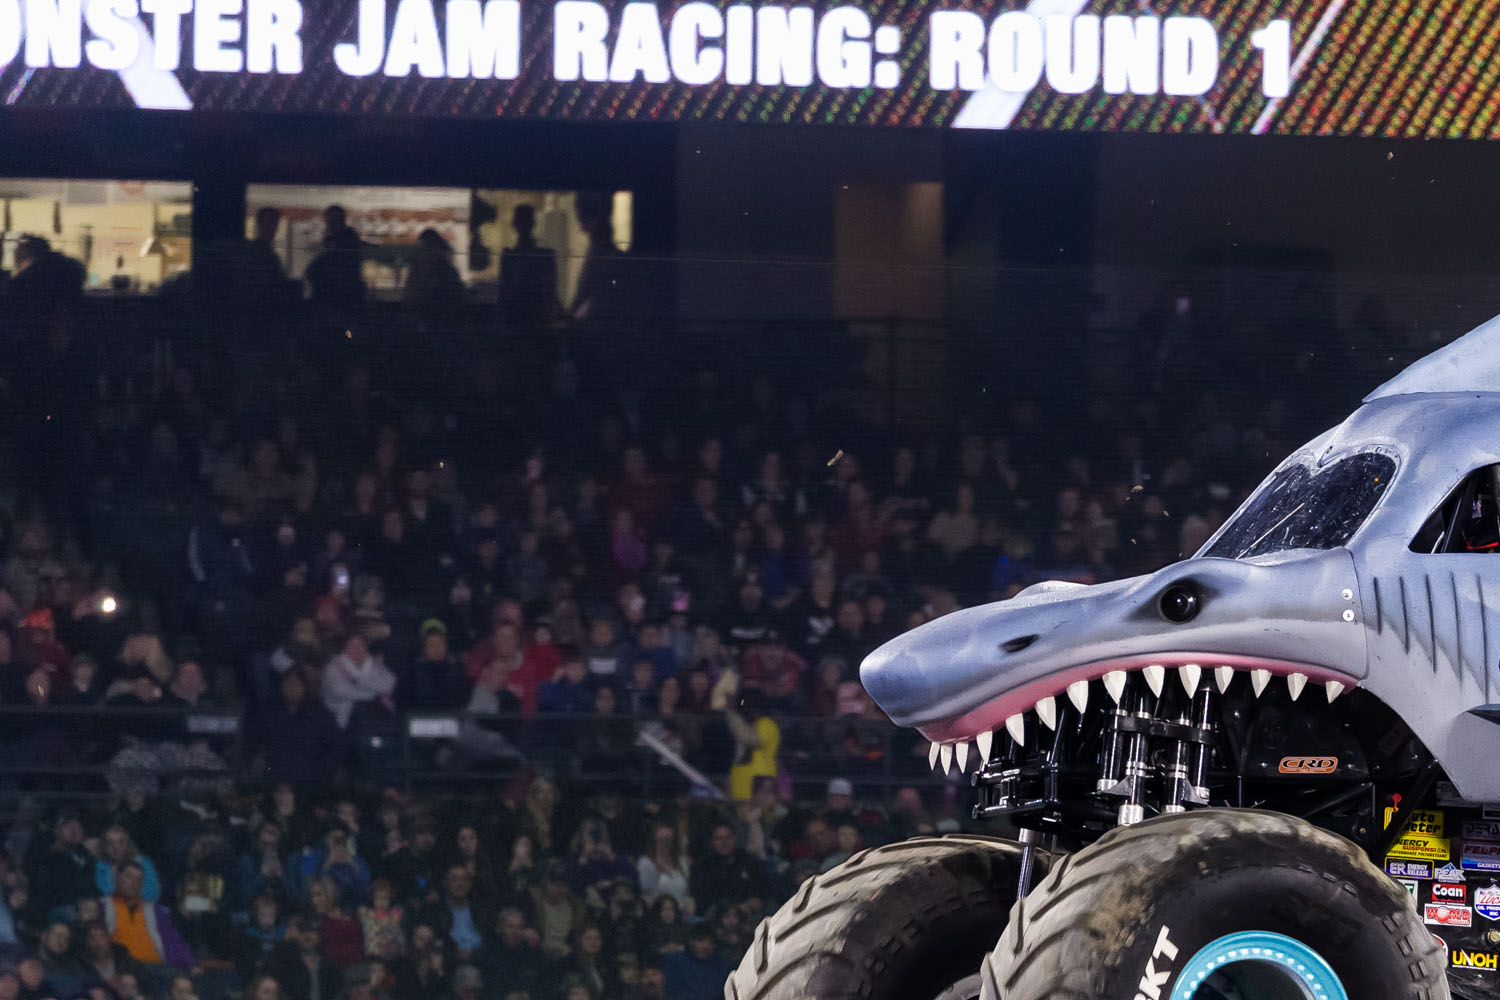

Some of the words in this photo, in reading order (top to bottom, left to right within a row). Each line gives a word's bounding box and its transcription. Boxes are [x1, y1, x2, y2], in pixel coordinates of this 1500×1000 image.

[0, 0, 304, 75] NSTER
[333, 0, 520, 79] JAM
[554, 0, 902, 89] RACING:
[929, 10, 1219, 97] ROUND
[1251, 19, 1291, 98] 1
[1432, 883, 1464, 898] Coan
[1452, 949, 1498, 968] UNOH
